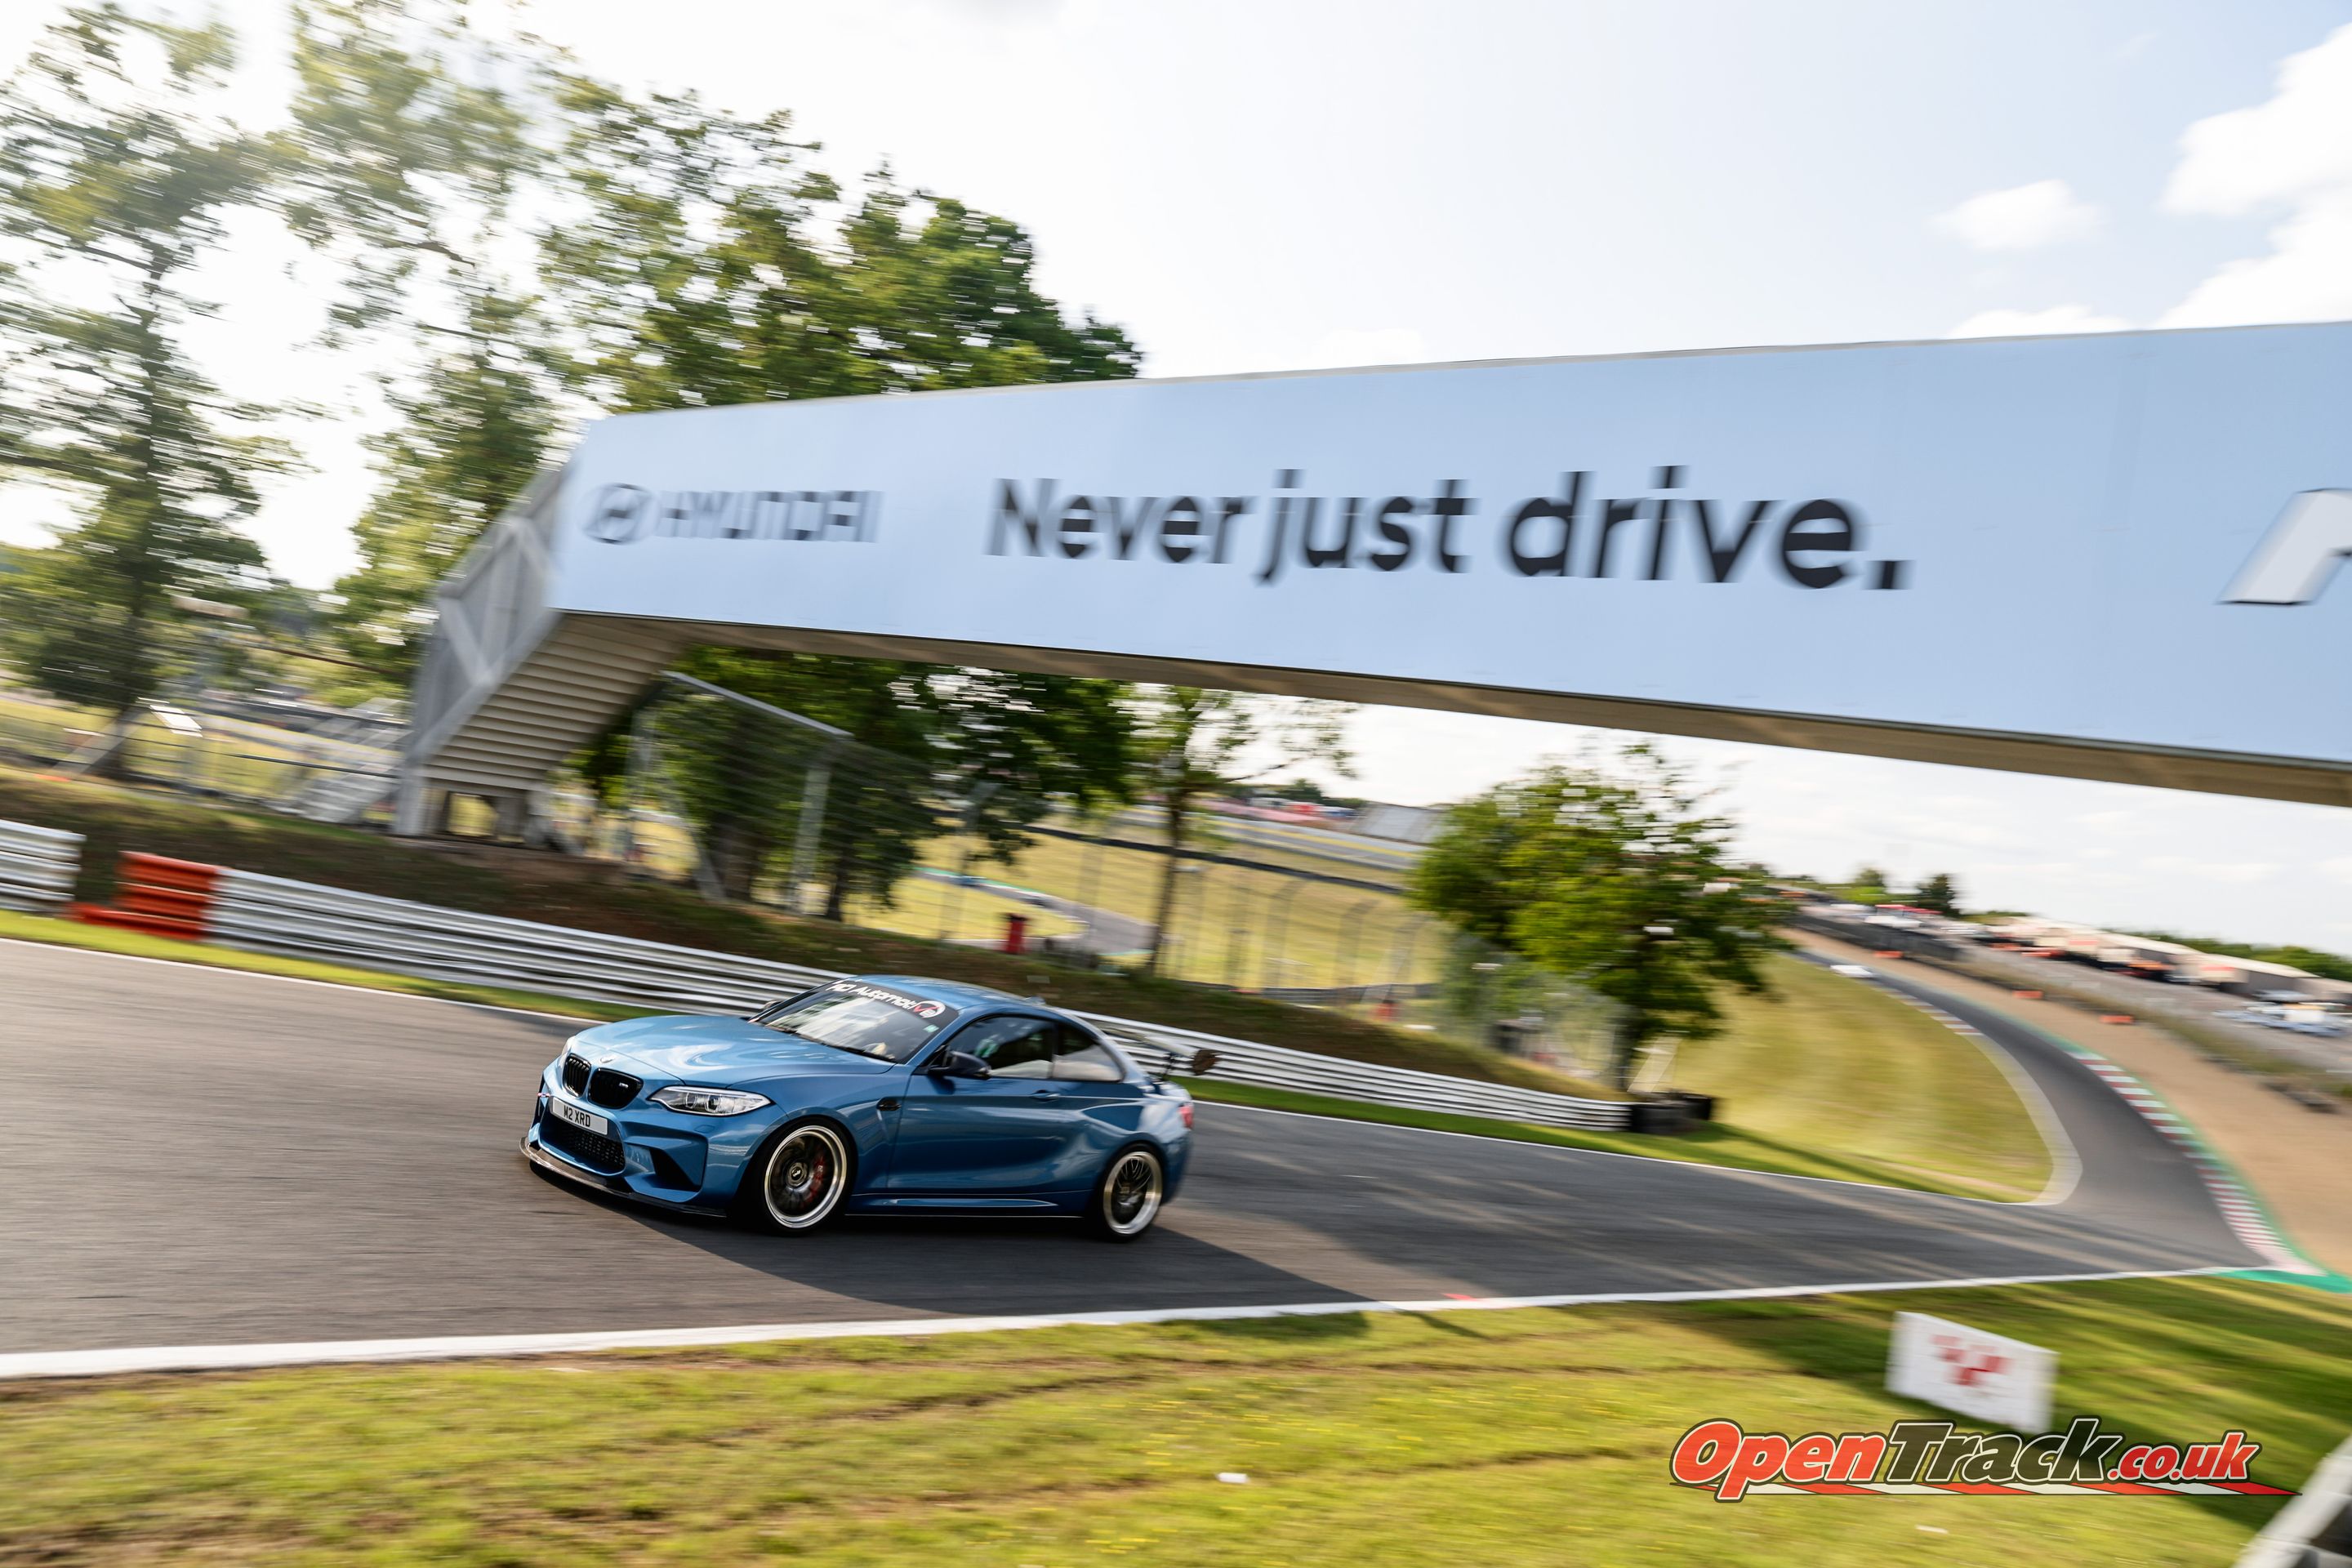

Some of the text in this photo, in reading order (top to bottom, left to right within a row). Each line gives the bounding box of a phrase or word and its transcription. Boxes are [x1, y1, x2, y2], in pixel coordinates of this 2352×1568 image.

[985, 465, 1916, 590] Never just drive.
[564, 1105, 590, 1128] M2 XRD
